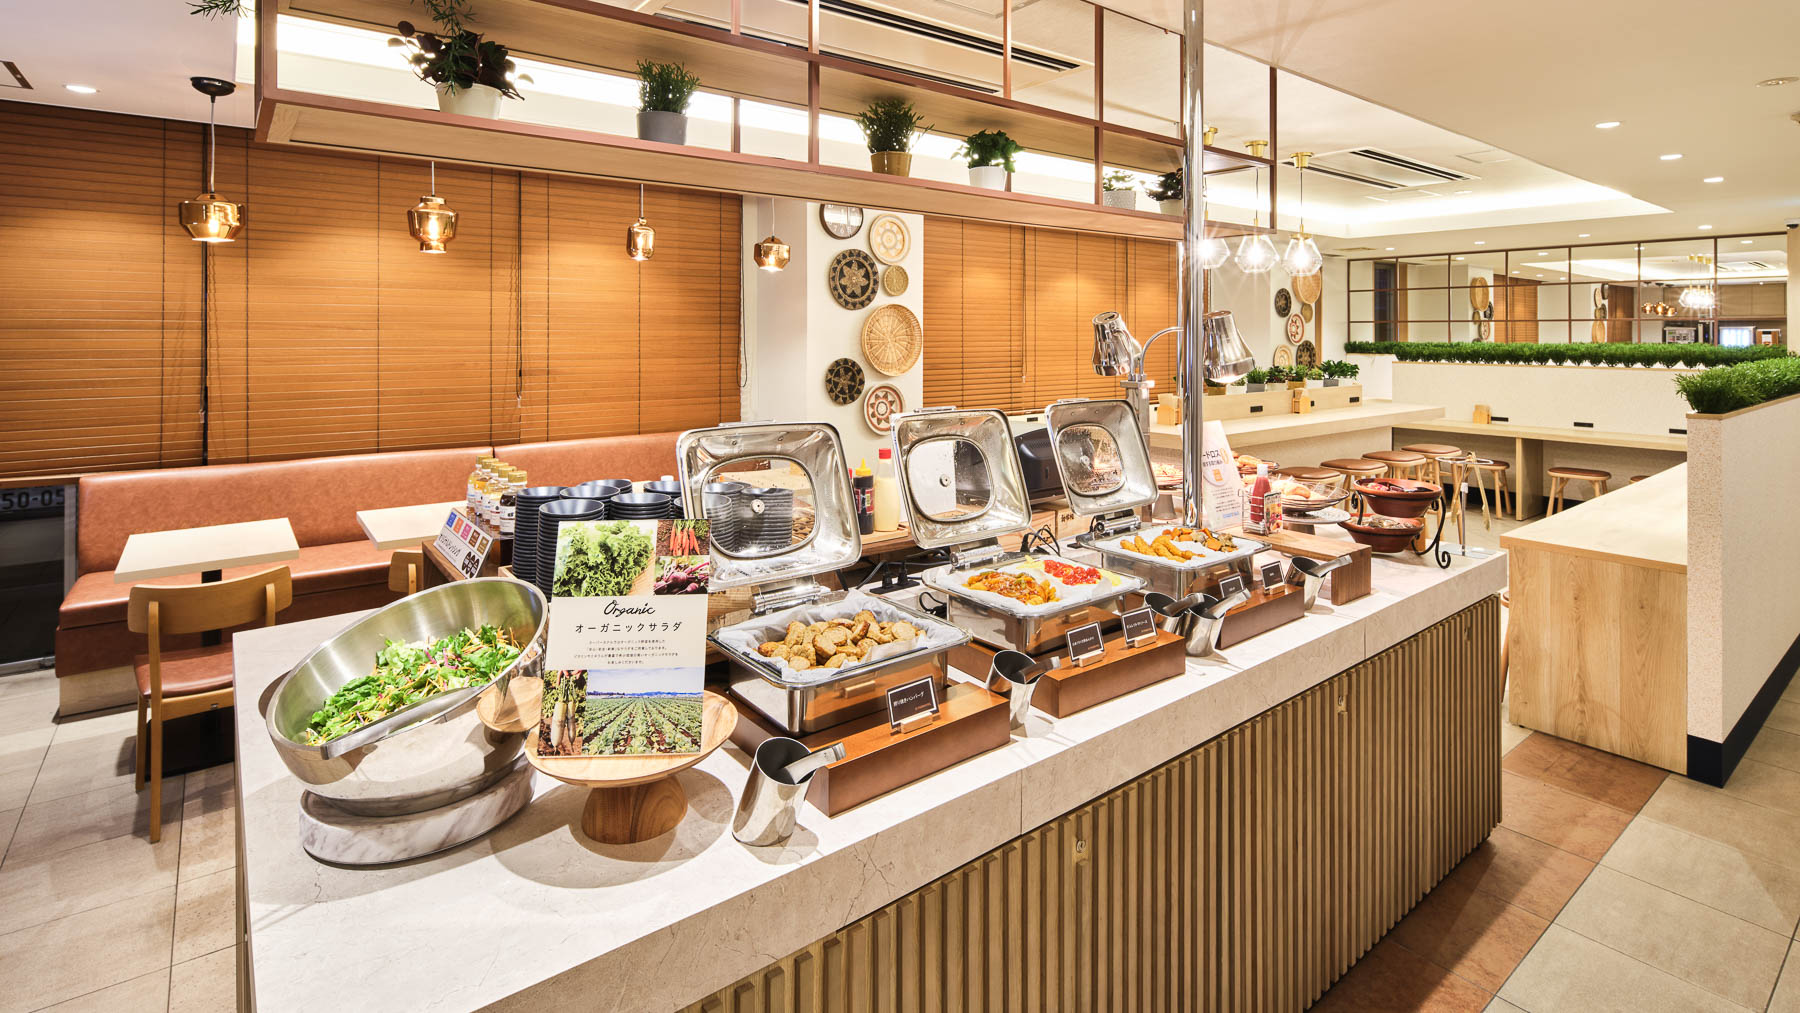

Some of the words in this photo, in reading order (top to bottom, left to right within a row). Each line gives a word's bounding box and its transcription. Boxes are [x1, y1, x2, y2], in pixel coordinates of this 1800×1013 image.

[603, 599, 656, 618] Organic
[575, 621, 682, 634] オーガニックサラダ
